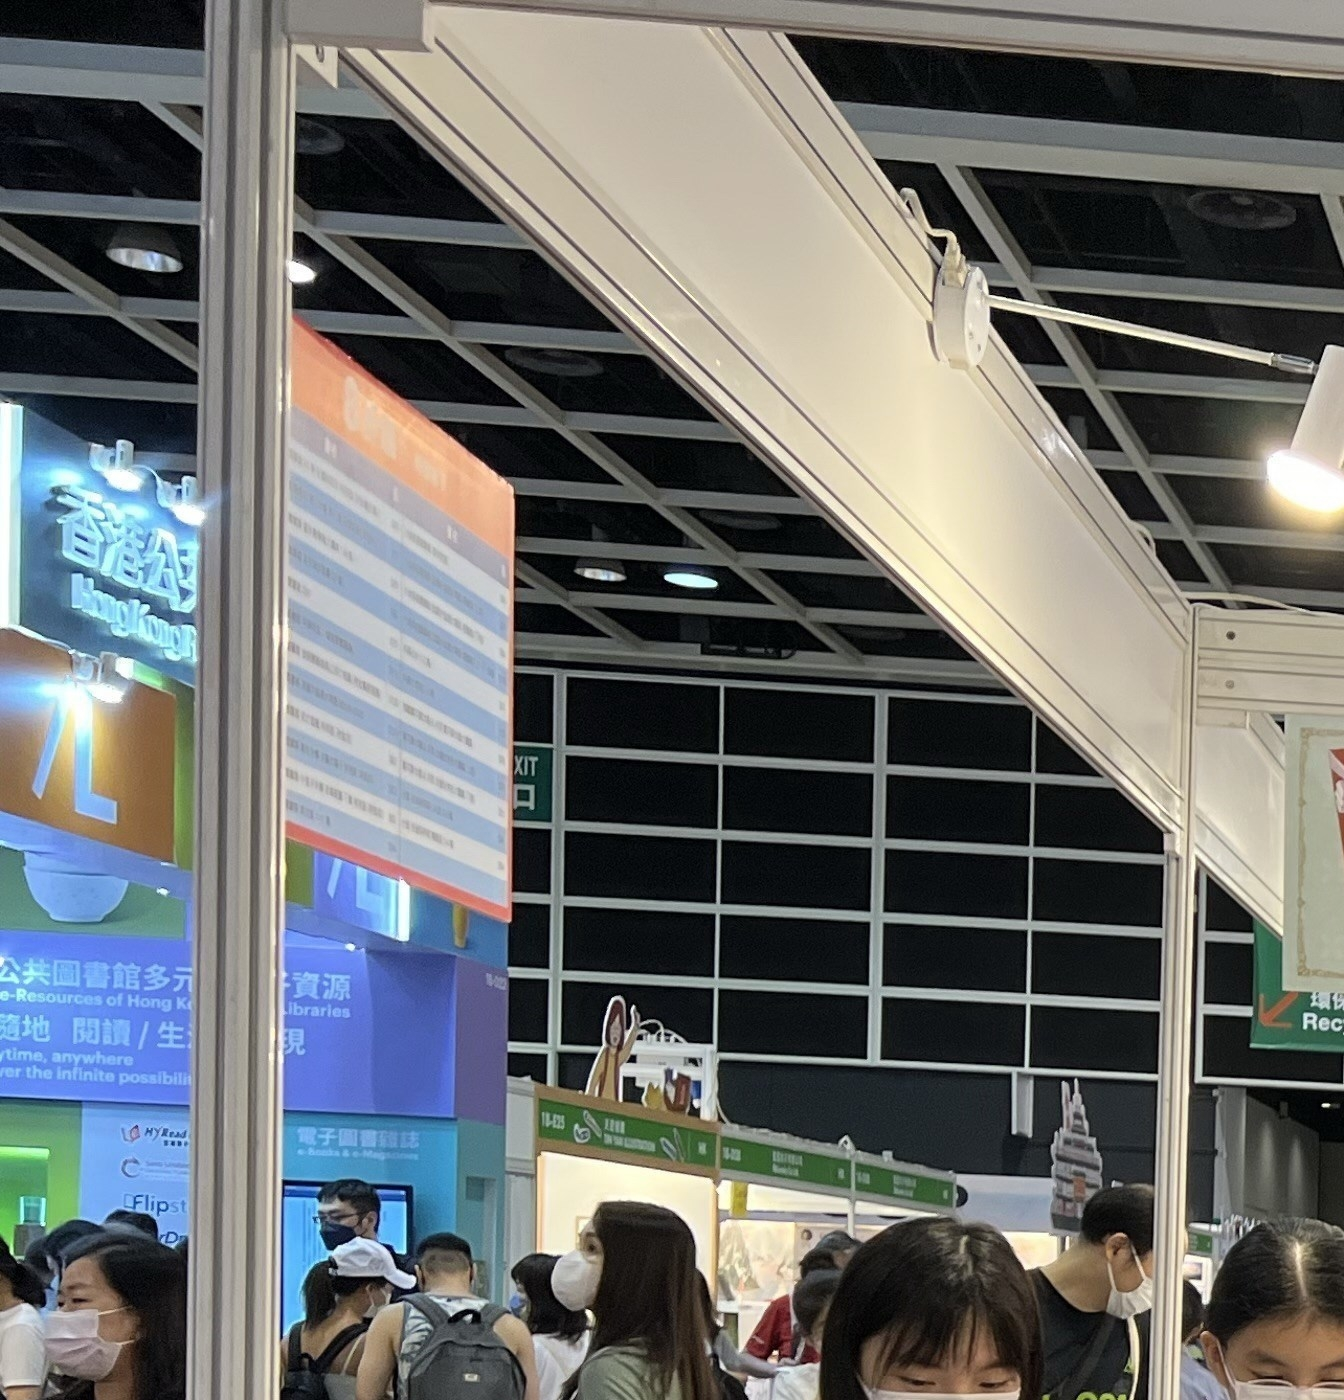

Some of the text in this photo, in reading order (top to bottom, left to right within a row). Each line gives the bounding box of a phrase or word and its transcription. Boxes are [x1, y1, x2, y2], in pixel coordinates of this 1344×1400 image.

[513, 755, 539, 777] XIT
[106, 993, 122, 1007] of
[127, 994, 172, 1012] Hong
[157, 1021, 192, 1049] 生
[52, 1051, 134, 1067] anywhere
[26, 1065, 52, 1080] the
[57, 1066, 115, 1083] infinite
